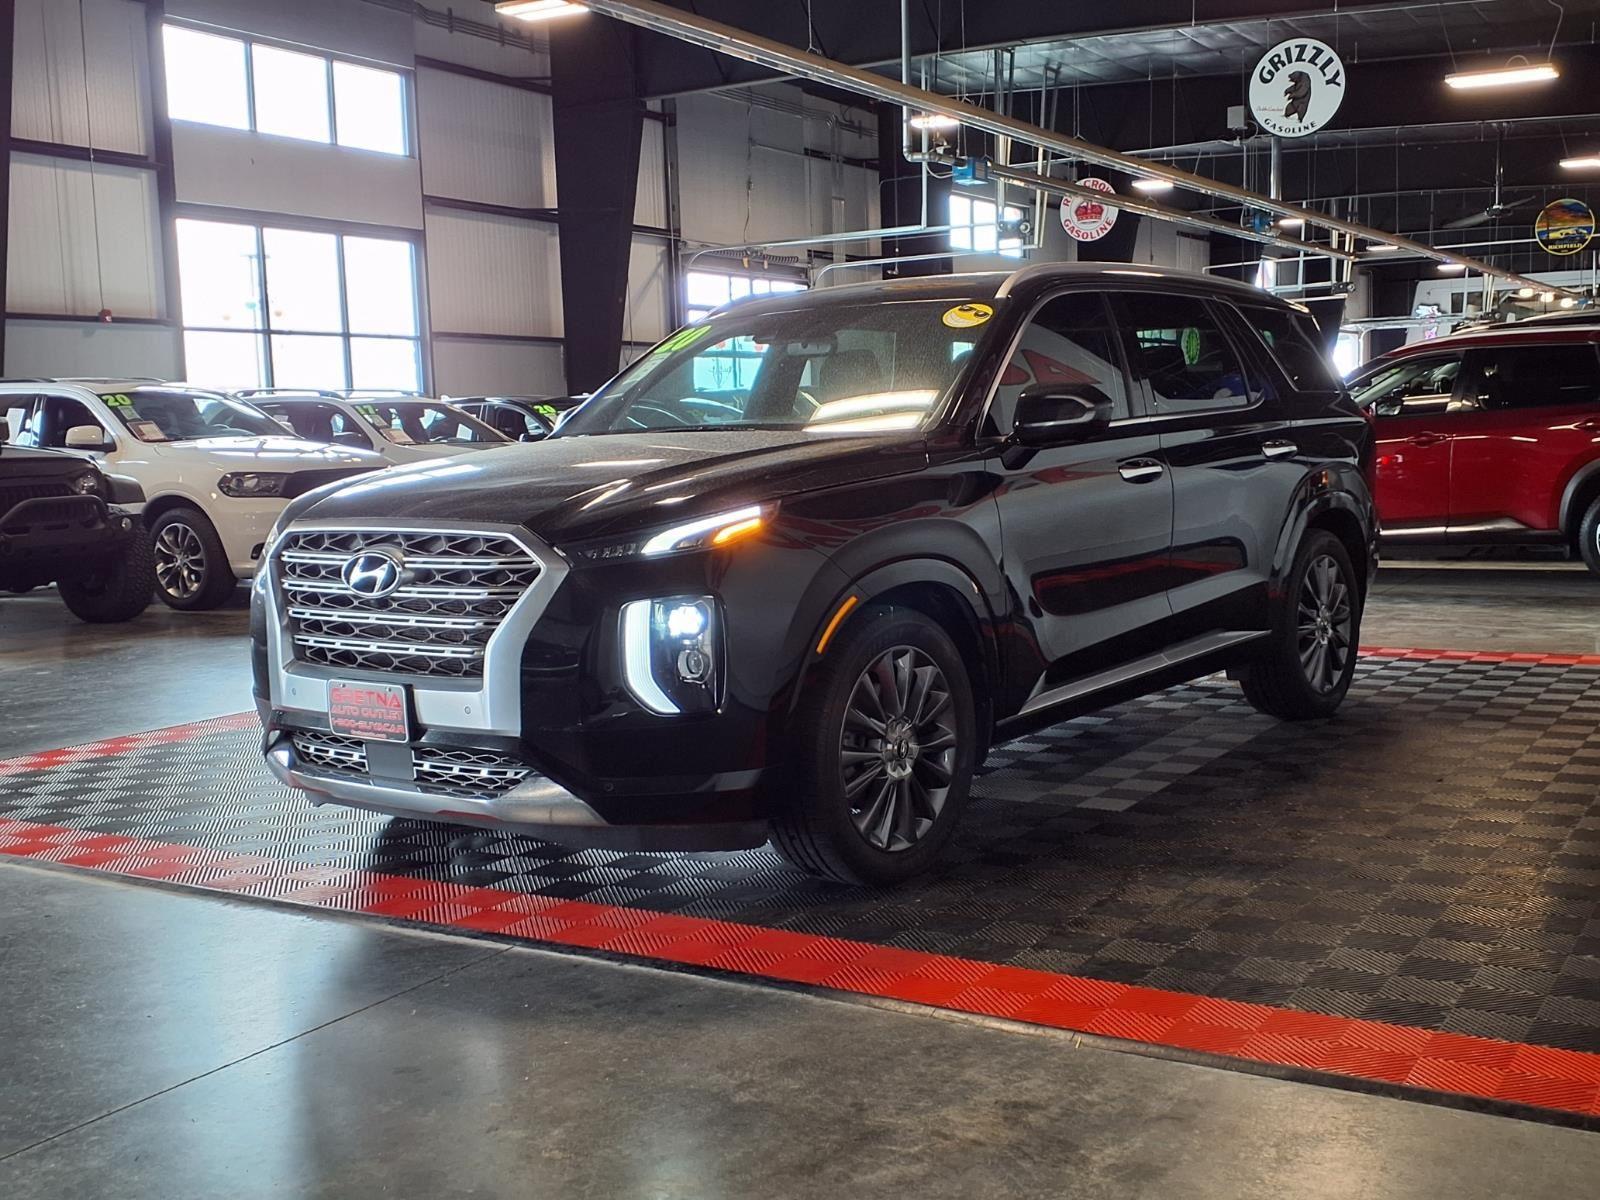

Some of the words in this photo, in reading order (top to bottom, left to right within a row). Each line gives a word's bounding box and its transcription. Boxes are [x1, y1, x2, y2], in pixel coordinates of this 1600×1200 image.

[1259, 44, 1341, 87] GRIZZLY
[1264, 118, 1317, 134] GASOLINE
[1083, 179, 1112, 193] CRO
[1063, 217, 1114, 240] GASOLINE
[101, 394, 132, 406] 20
[355, 404, 376, 415] 17
[533, 405, 557, 414] 20
[331, 687, 402, 708] GRETNA
[331, 705, 360, 717] AUTO
[361, 707, 403, 721] OUTLET
